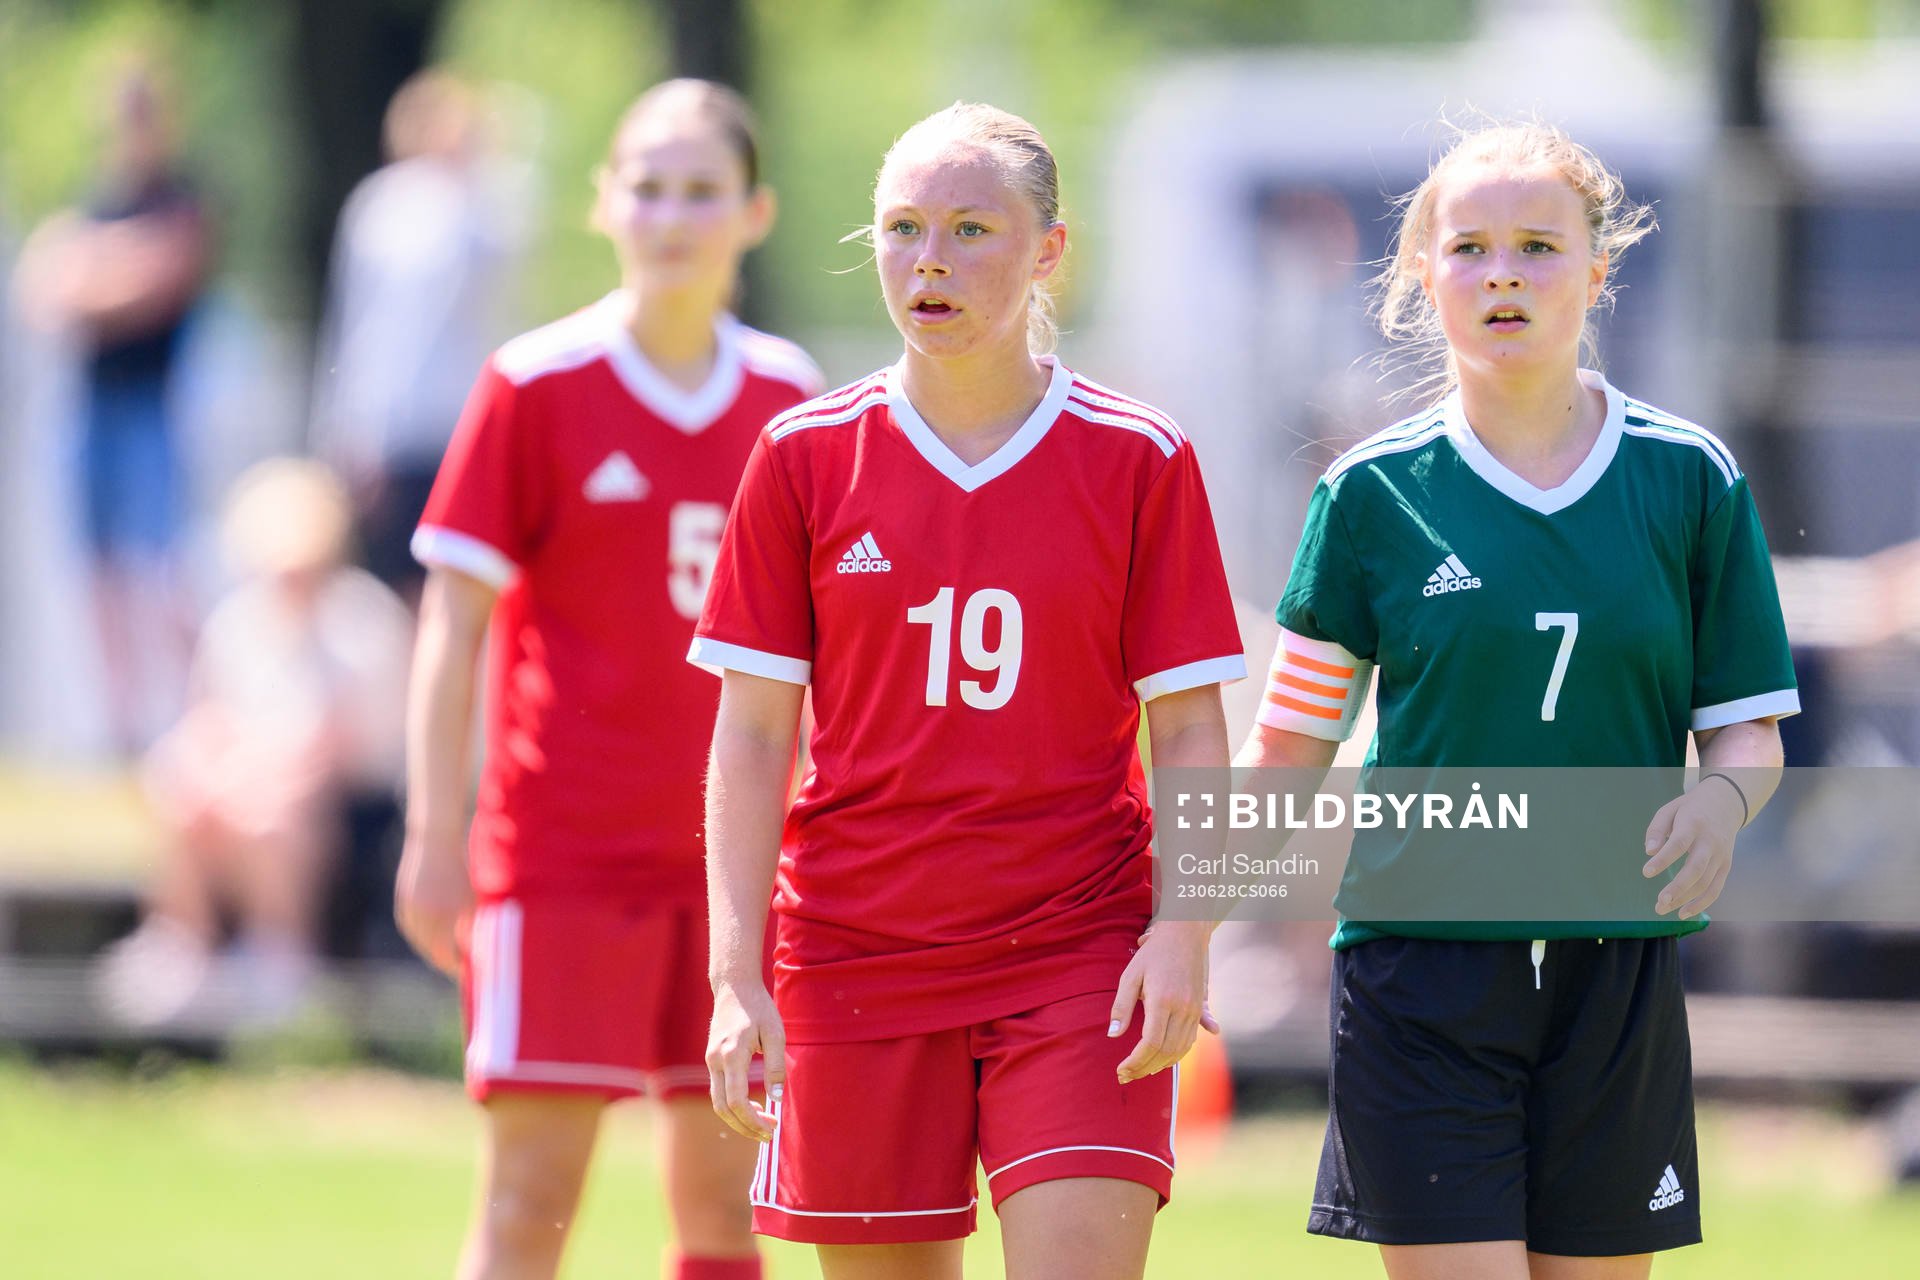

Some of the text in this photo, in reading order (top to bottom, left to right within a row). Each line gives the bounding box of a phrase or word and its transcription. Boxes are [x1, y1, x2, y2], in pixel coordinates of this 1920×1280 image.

[667, 500, 726, 620] 5
[836, 556, 892, 574] adidas
[1422, 576, 1482, 597] adidas
[907, 587, 1023, 711] 19
[1535, 612, 1579, 721] 7
[1649, 1189, 1684, 1211] adidas
